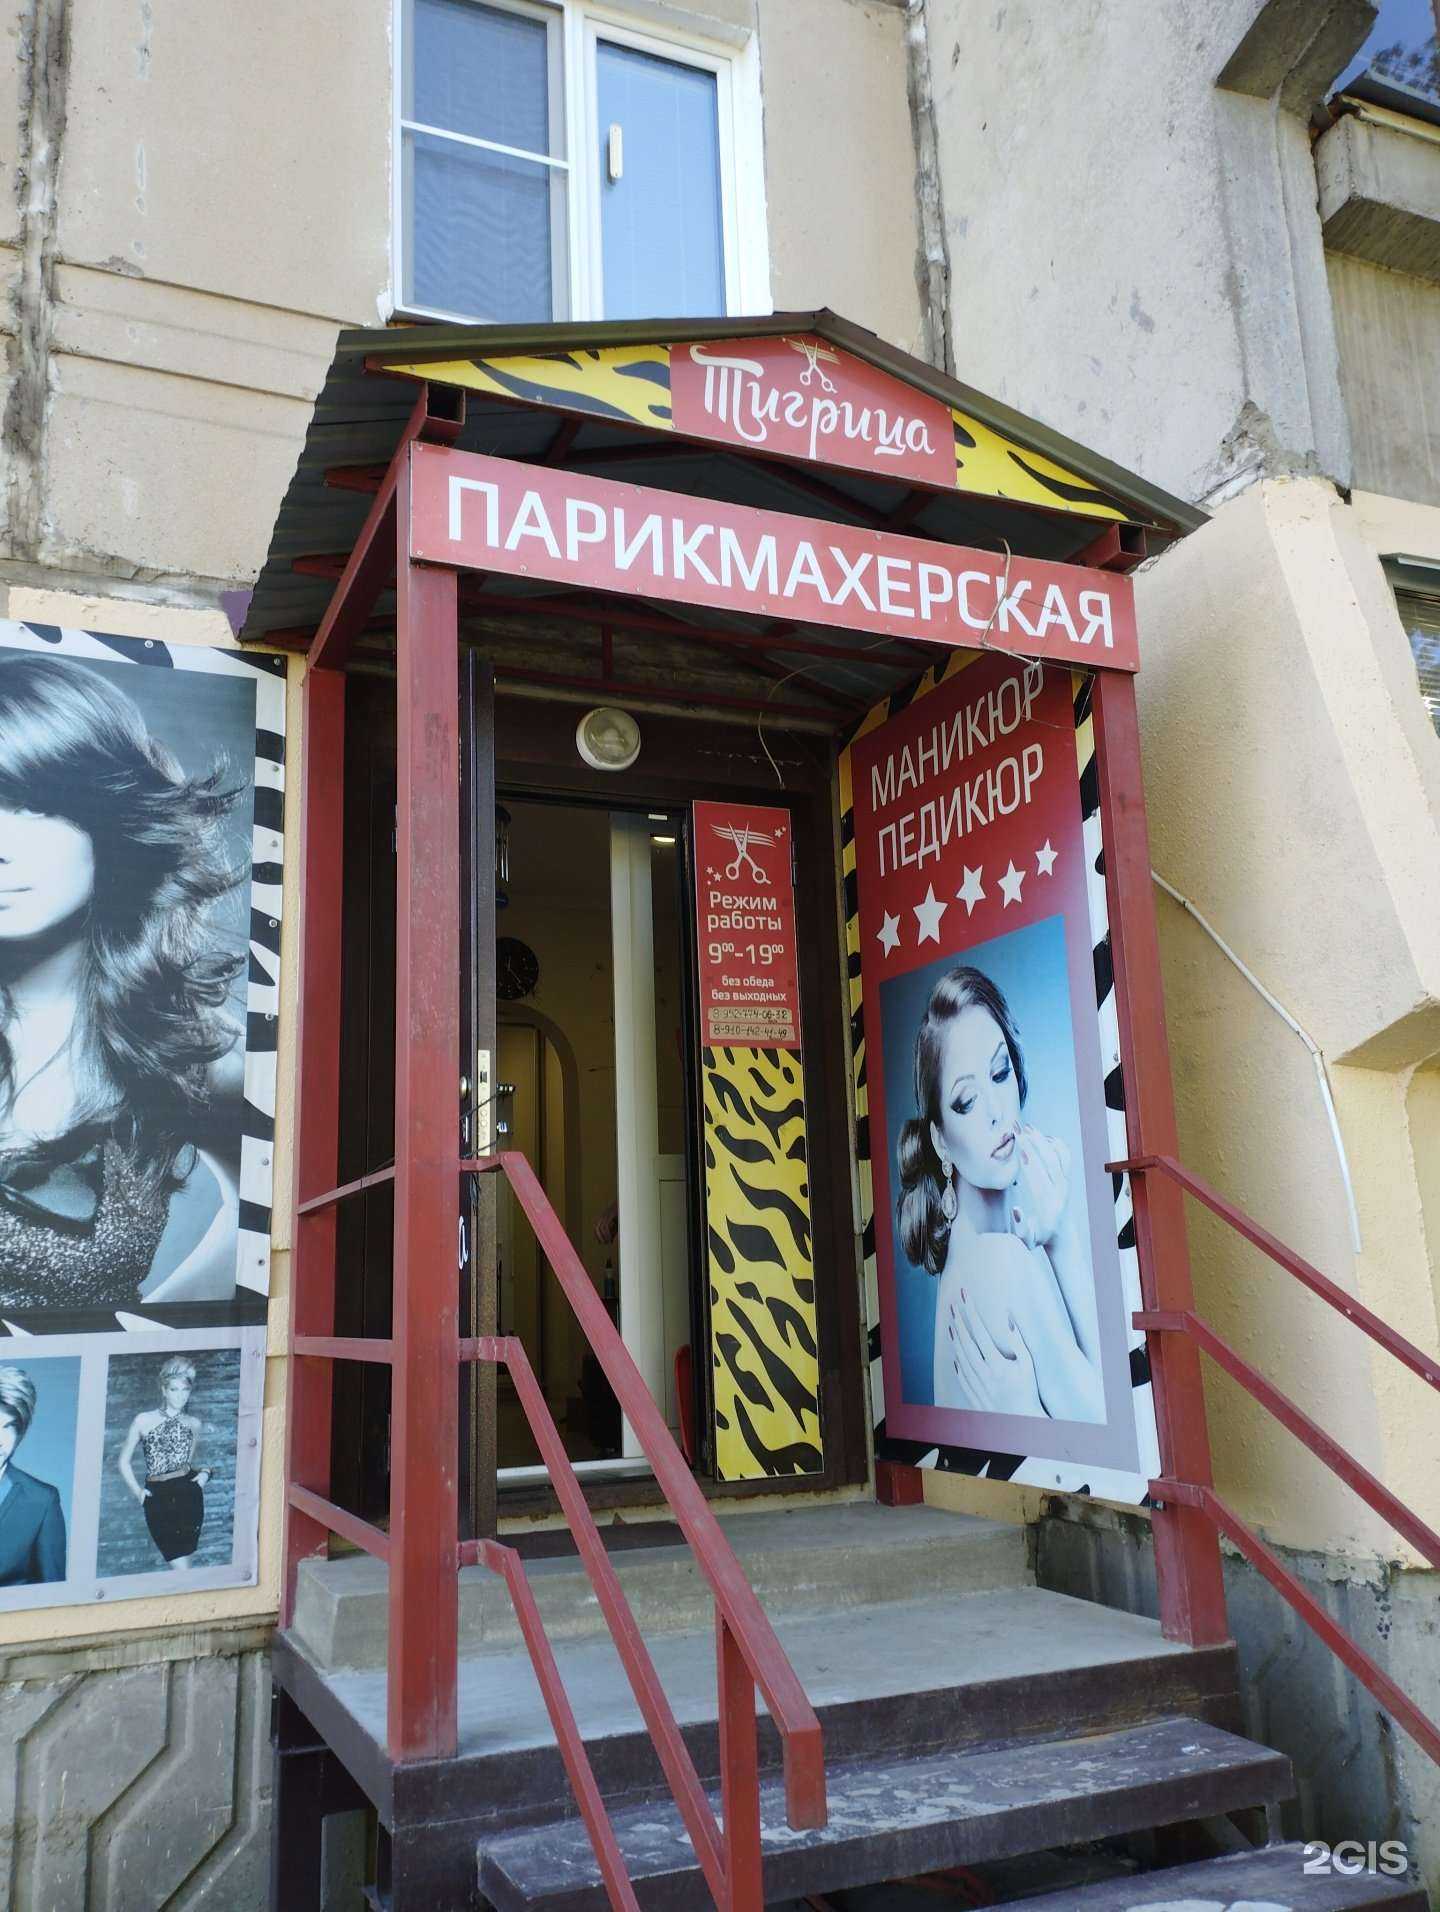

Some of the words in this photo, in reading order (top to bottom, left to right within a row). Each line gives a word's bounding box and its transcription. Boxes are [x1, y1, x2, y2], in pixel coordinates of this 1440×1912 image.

[689, 344, 936, 460] Тигрица
[447, 474, 1114, 649] ПАРИКМАХЕРСКАЯ
[870, 661, 1044, 812] МАНИКЮР
[877, 742, 1044, 878] ПЕДИКЮР
[707, 910, 782, 933] работы
[709, 890, 777, 911] Режим
[711, 988, 730, 1001] без
[732, 991, 787, 1003] выходных
[721, 974, 741, 987] без
[742, 975, 775, 989] обеда
